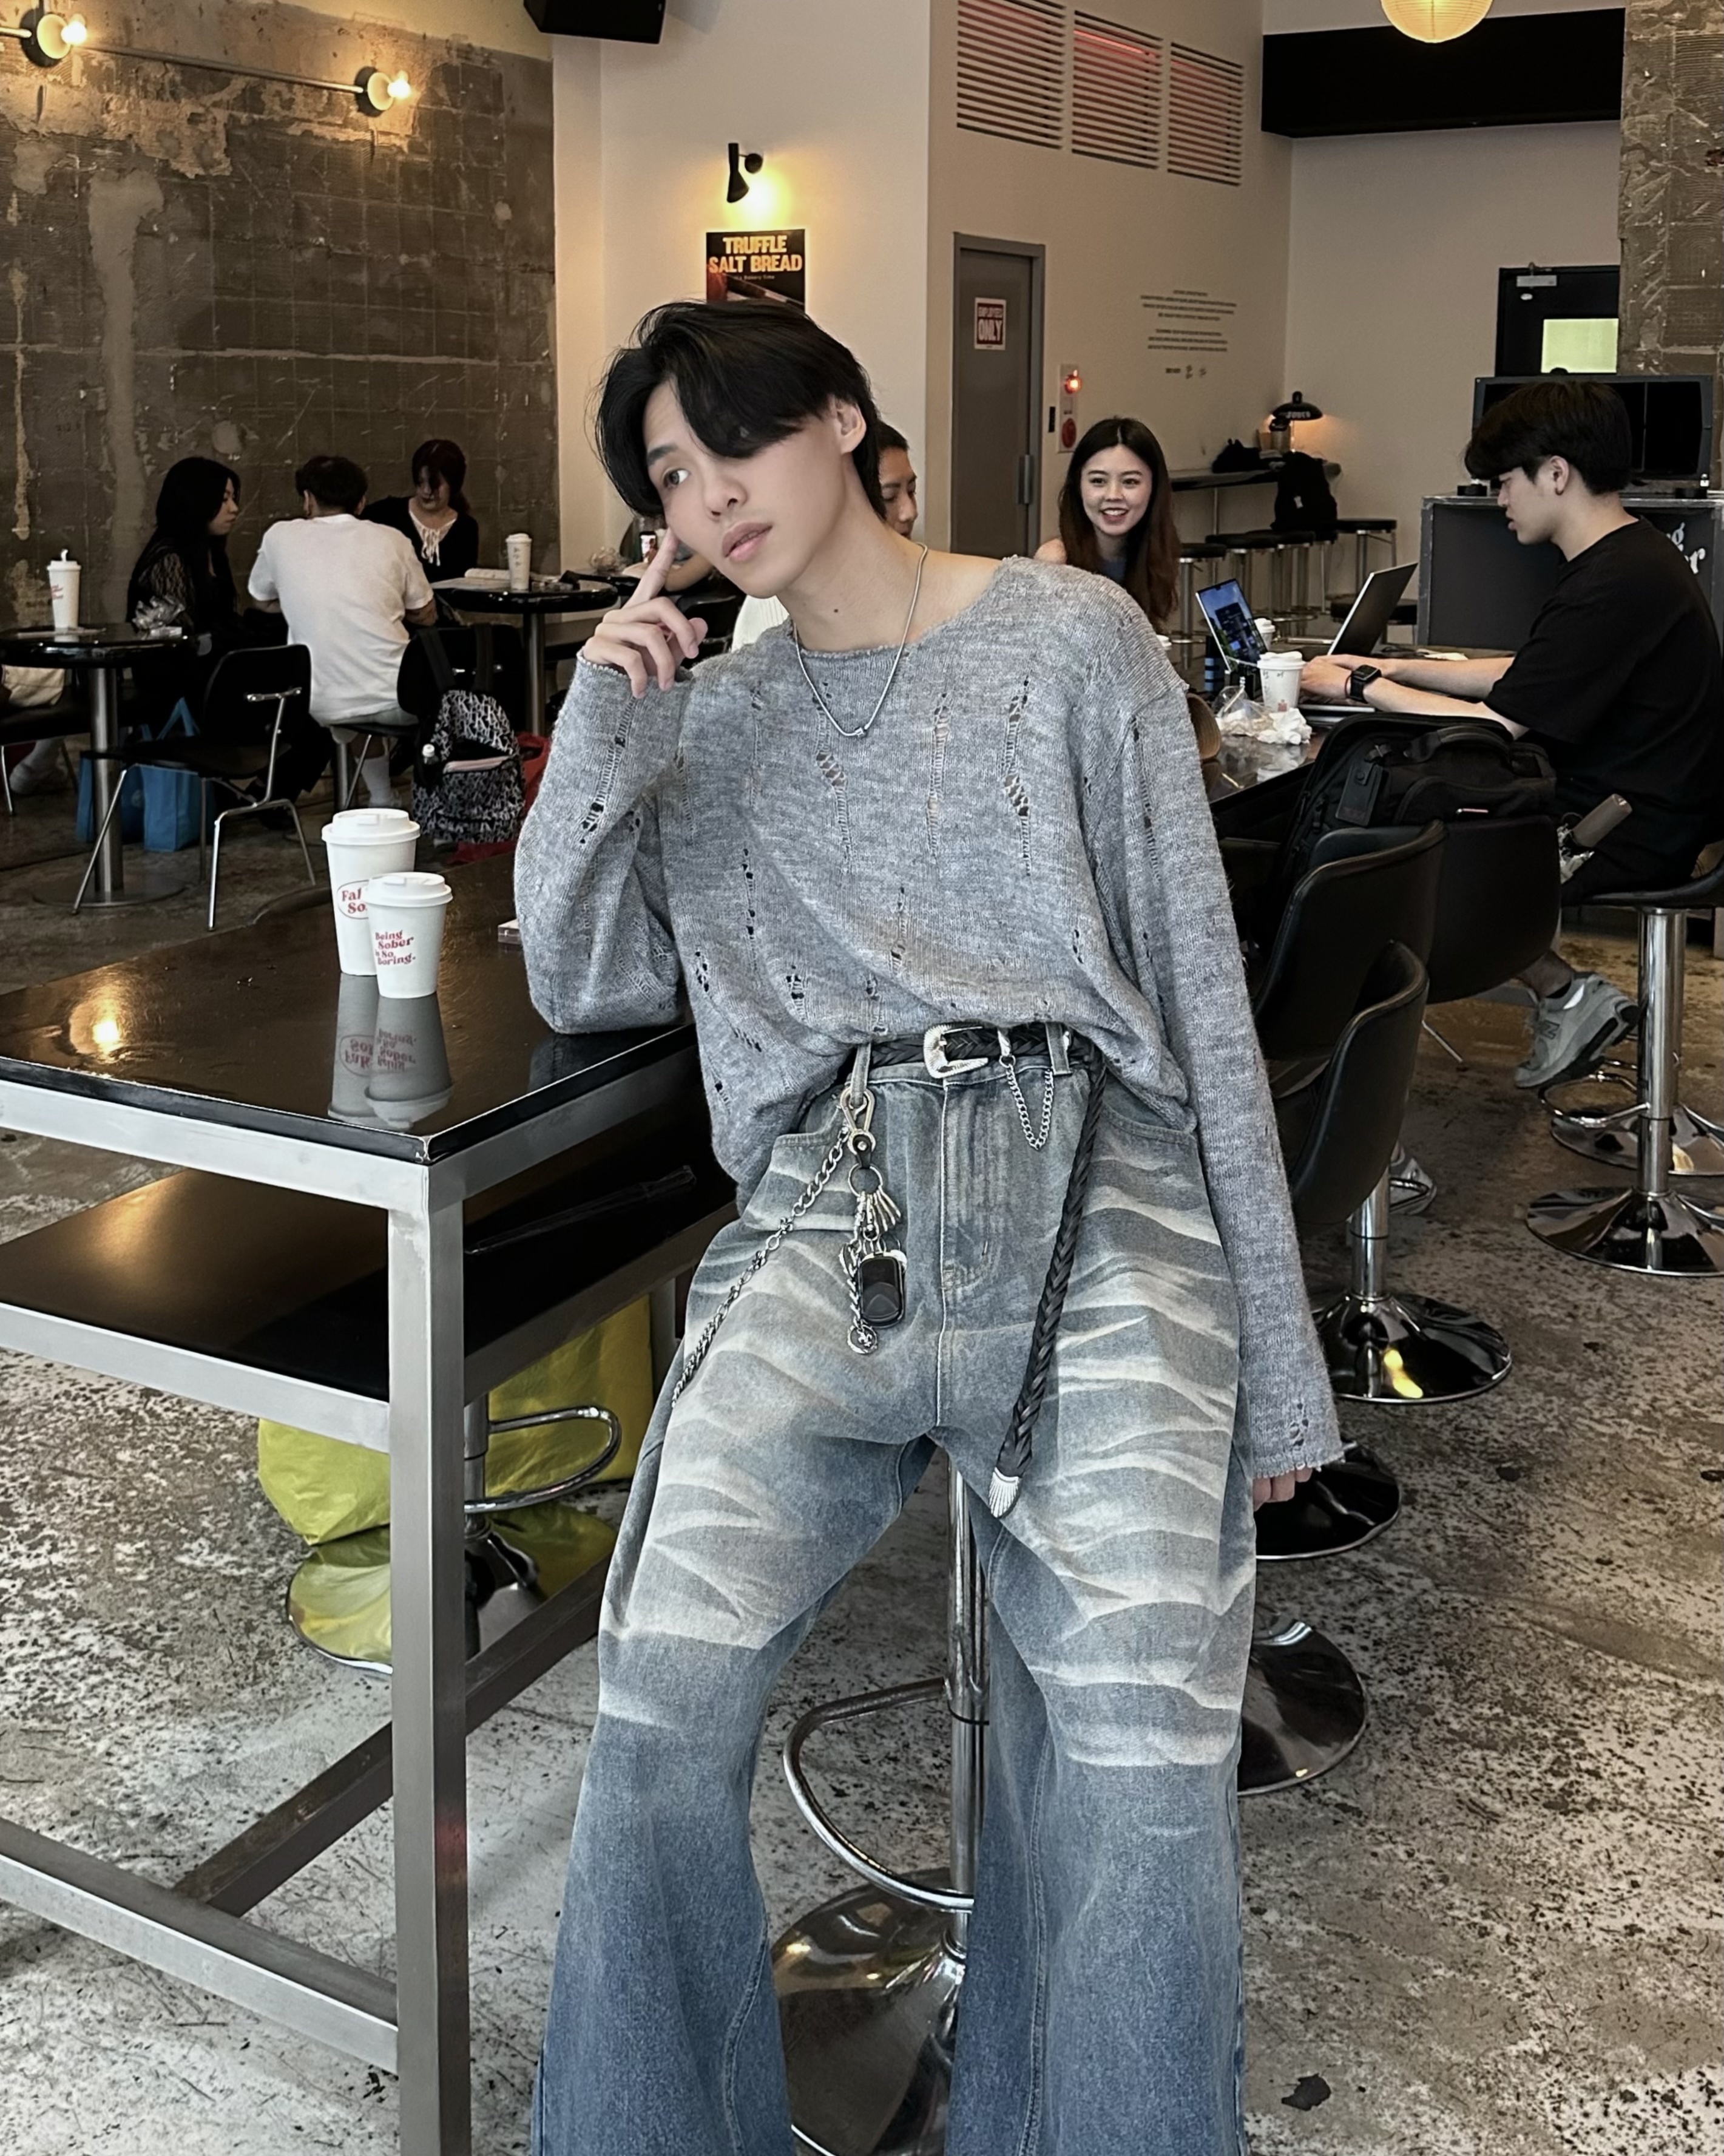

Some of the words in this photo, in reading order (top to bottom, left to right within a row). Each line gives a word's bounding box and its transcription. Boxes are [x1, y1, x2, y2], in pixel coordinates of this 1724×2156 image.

[722, 235, 788, 254] TRUFFLE
[709, 256, 747, 273] SALT
[750, 254, 802, 272] BREAD
[978, 319, 1002, 341] ONLY
[375, 930, 402, 940] Being
[378, 937, 414, 949] Sober
